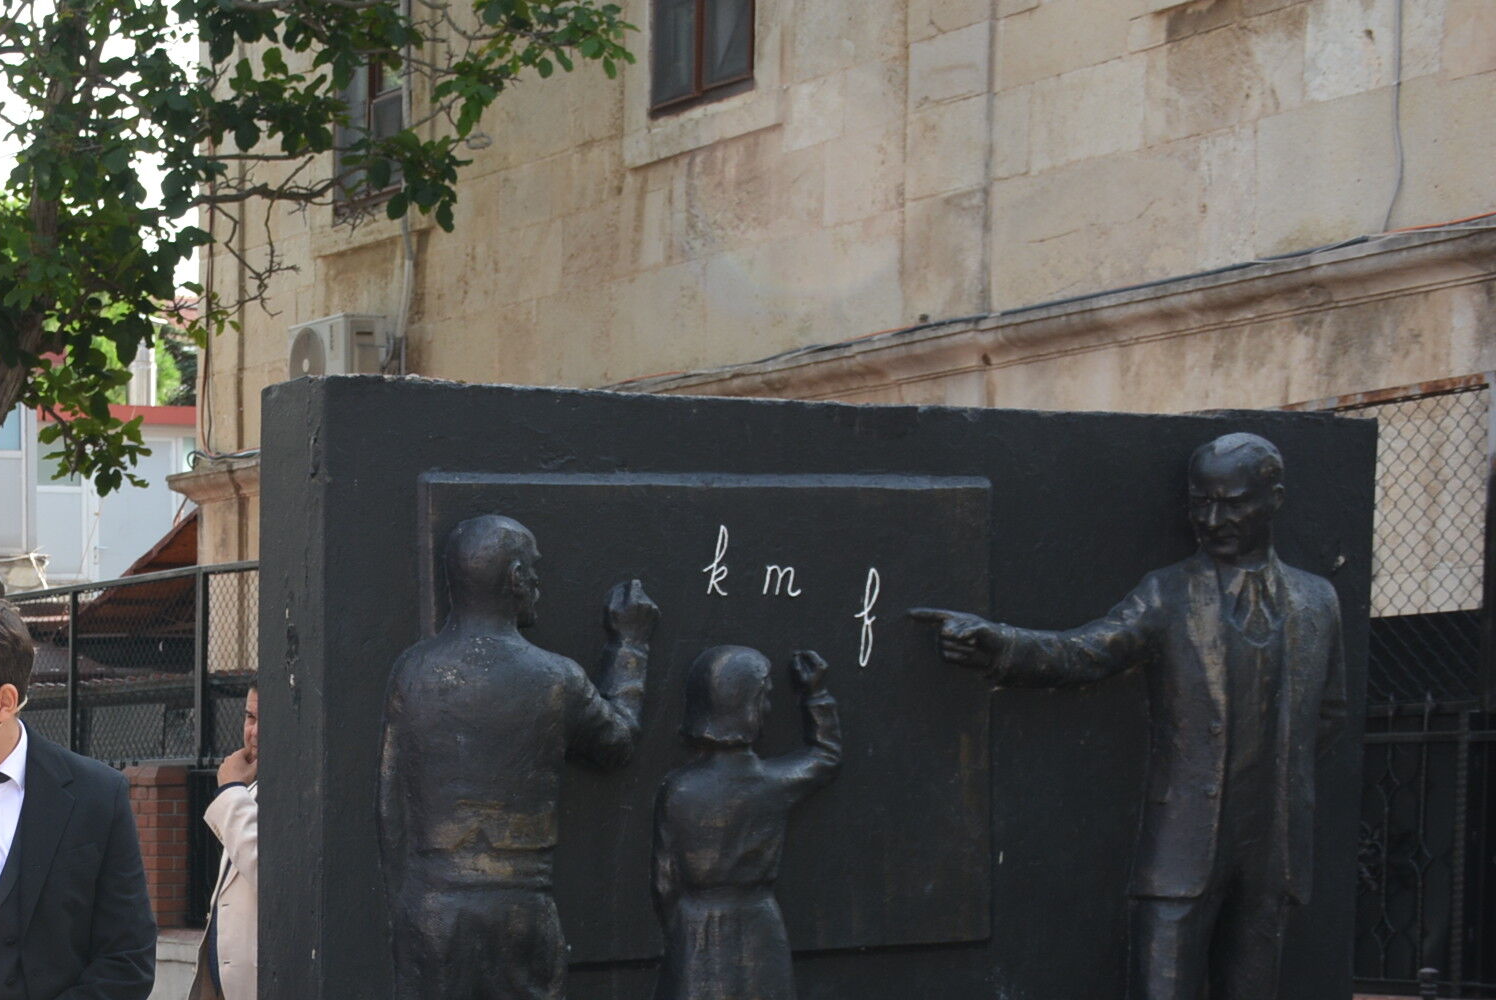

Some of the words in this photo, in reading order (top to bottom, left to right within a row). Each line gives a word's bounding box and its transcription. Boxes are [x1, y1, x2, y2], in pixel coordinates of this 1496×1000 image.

[702, 523, 729, 597] k
[762, 564, 802, 597] m
[853, 567, 881, 668] f
